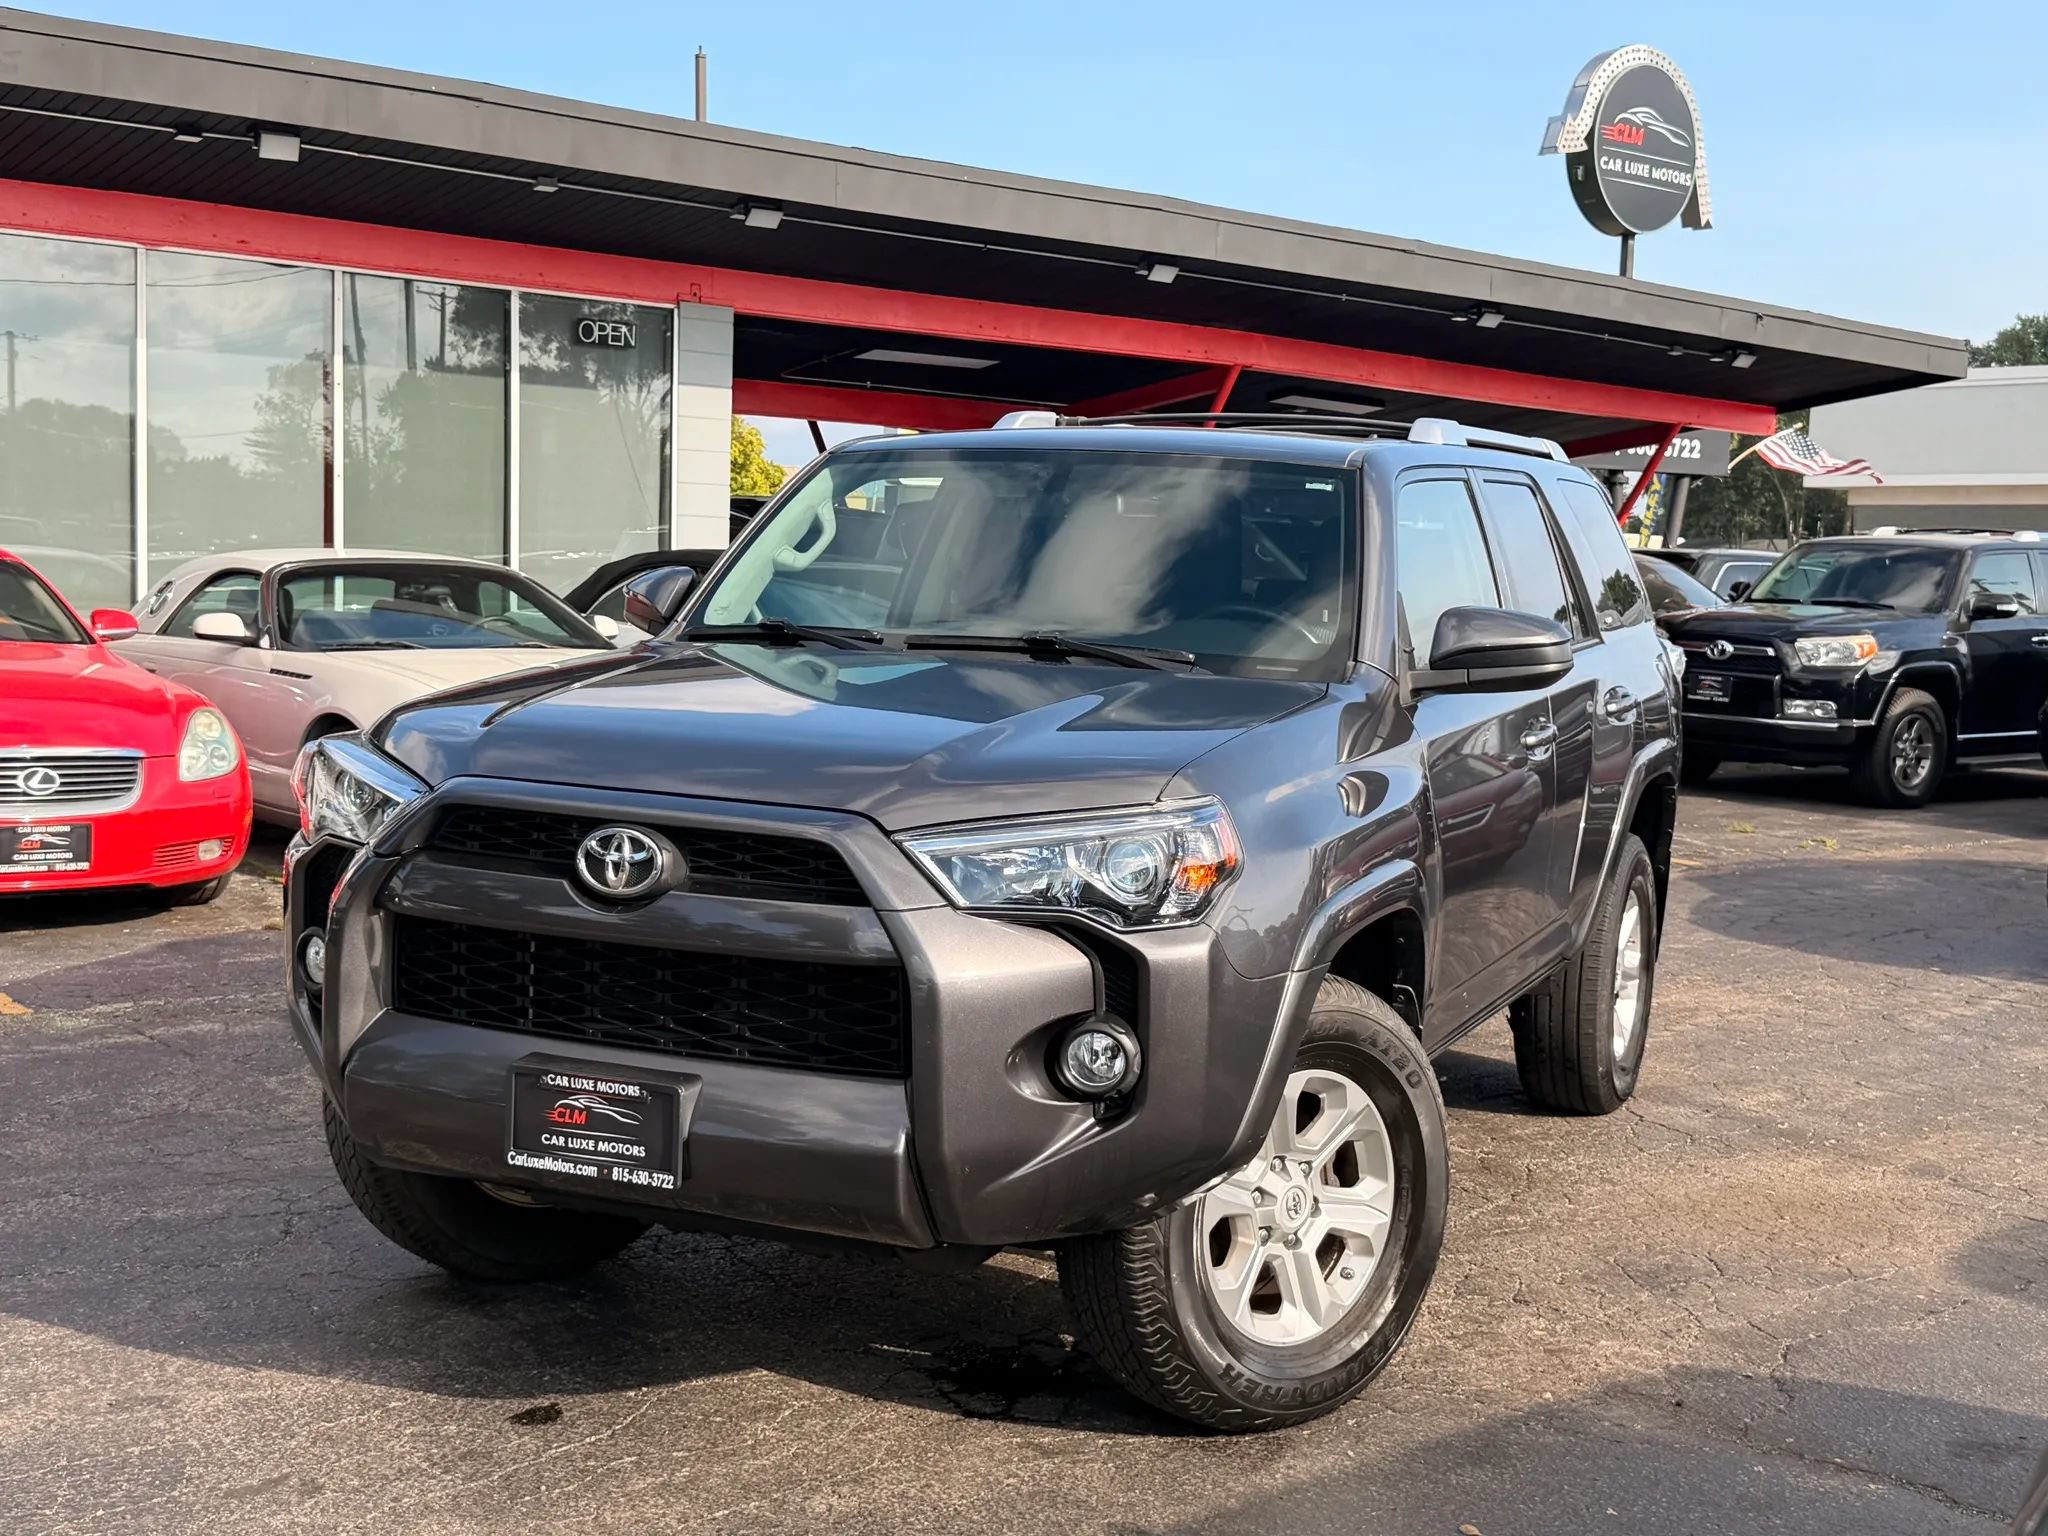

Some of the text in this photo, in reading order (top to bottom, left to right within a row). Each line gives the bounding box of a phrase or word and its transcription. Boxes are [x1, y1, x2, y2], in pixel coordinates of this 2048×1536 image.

[1614, 123, 1645, 146] CLM
[1600, 156, 1692, 187] CAR LUXE MOTORS
[579, 320, 636, 346] OPEN
[547, 1074, 640, 1097] CAR LUXE MOTORS
[555, 1107, 587, 1125] CLM
[541, 1133, 646, 1157] CAR LUXE MOTORS
[507, 1151, 674, 1190] CarLuxeMotors.com 815-630-3722
